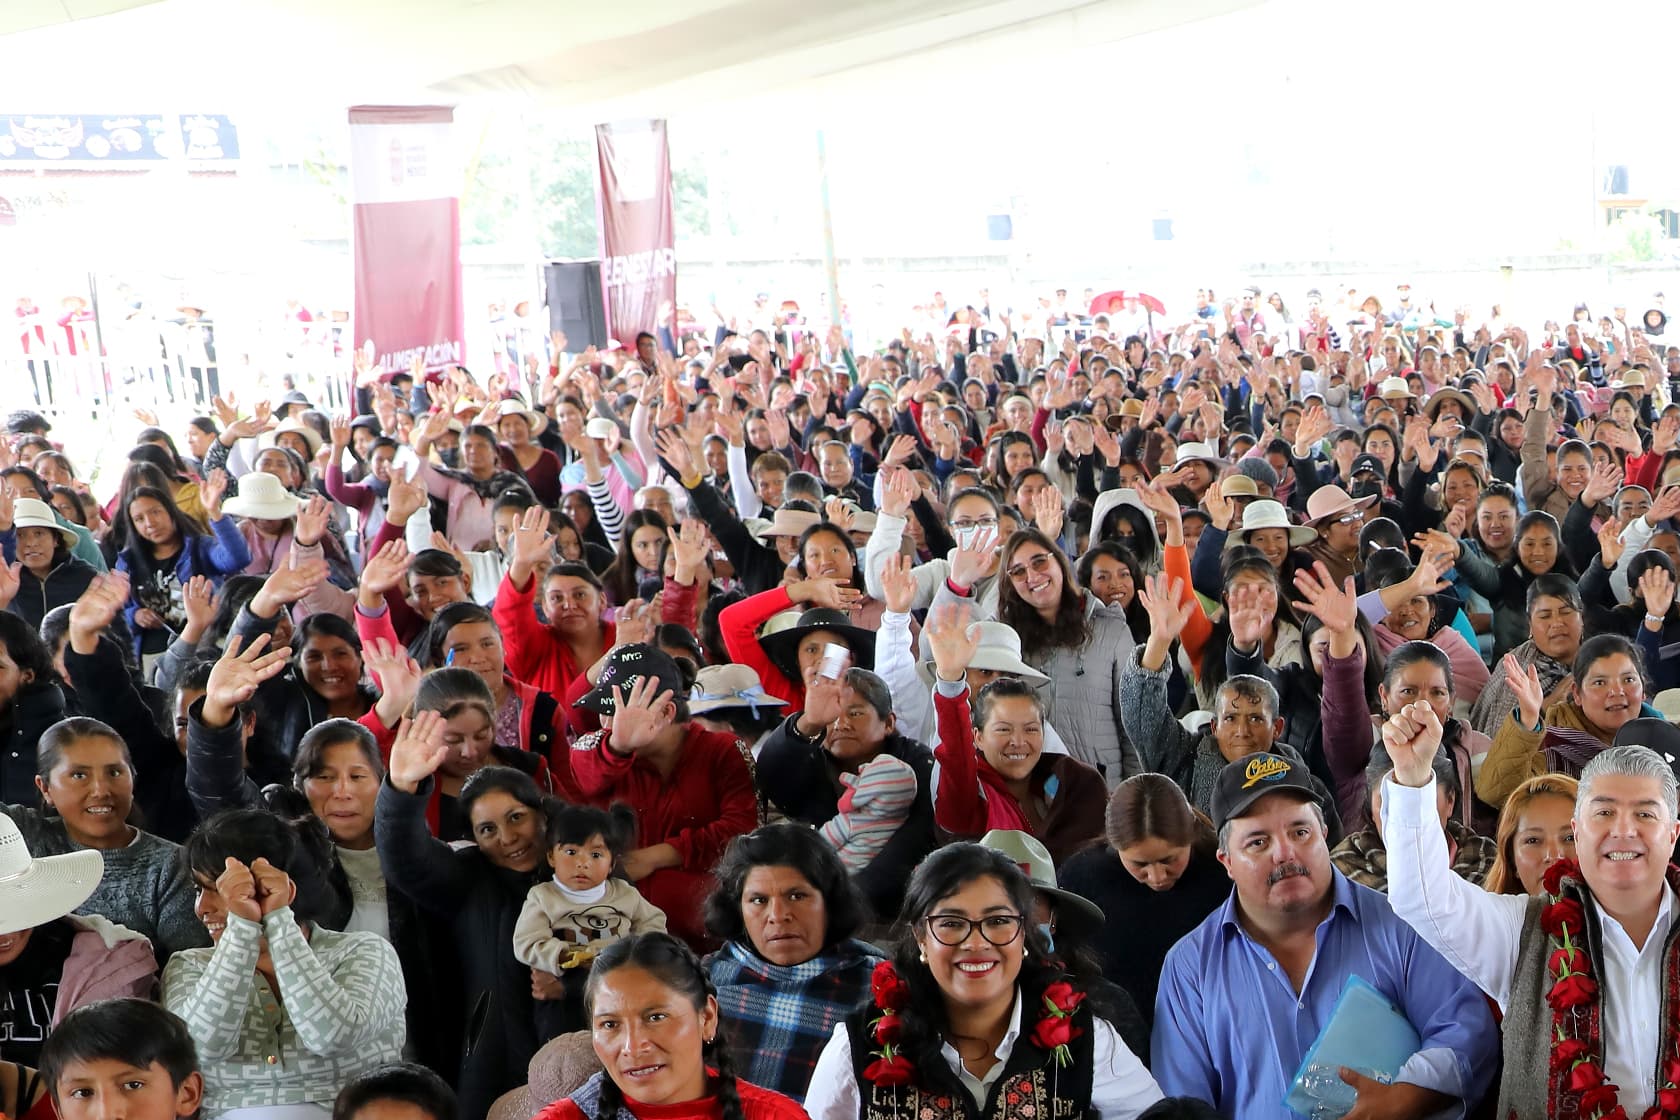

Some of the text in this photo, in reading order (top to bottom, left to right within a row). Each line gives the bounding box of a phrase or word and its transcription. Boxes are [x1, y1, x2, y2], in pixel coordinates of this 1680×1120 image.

[621, 652, 643, 663] NYC
[602, 666, 617, 684] NYC
[601, 697, 615, 706] NY
